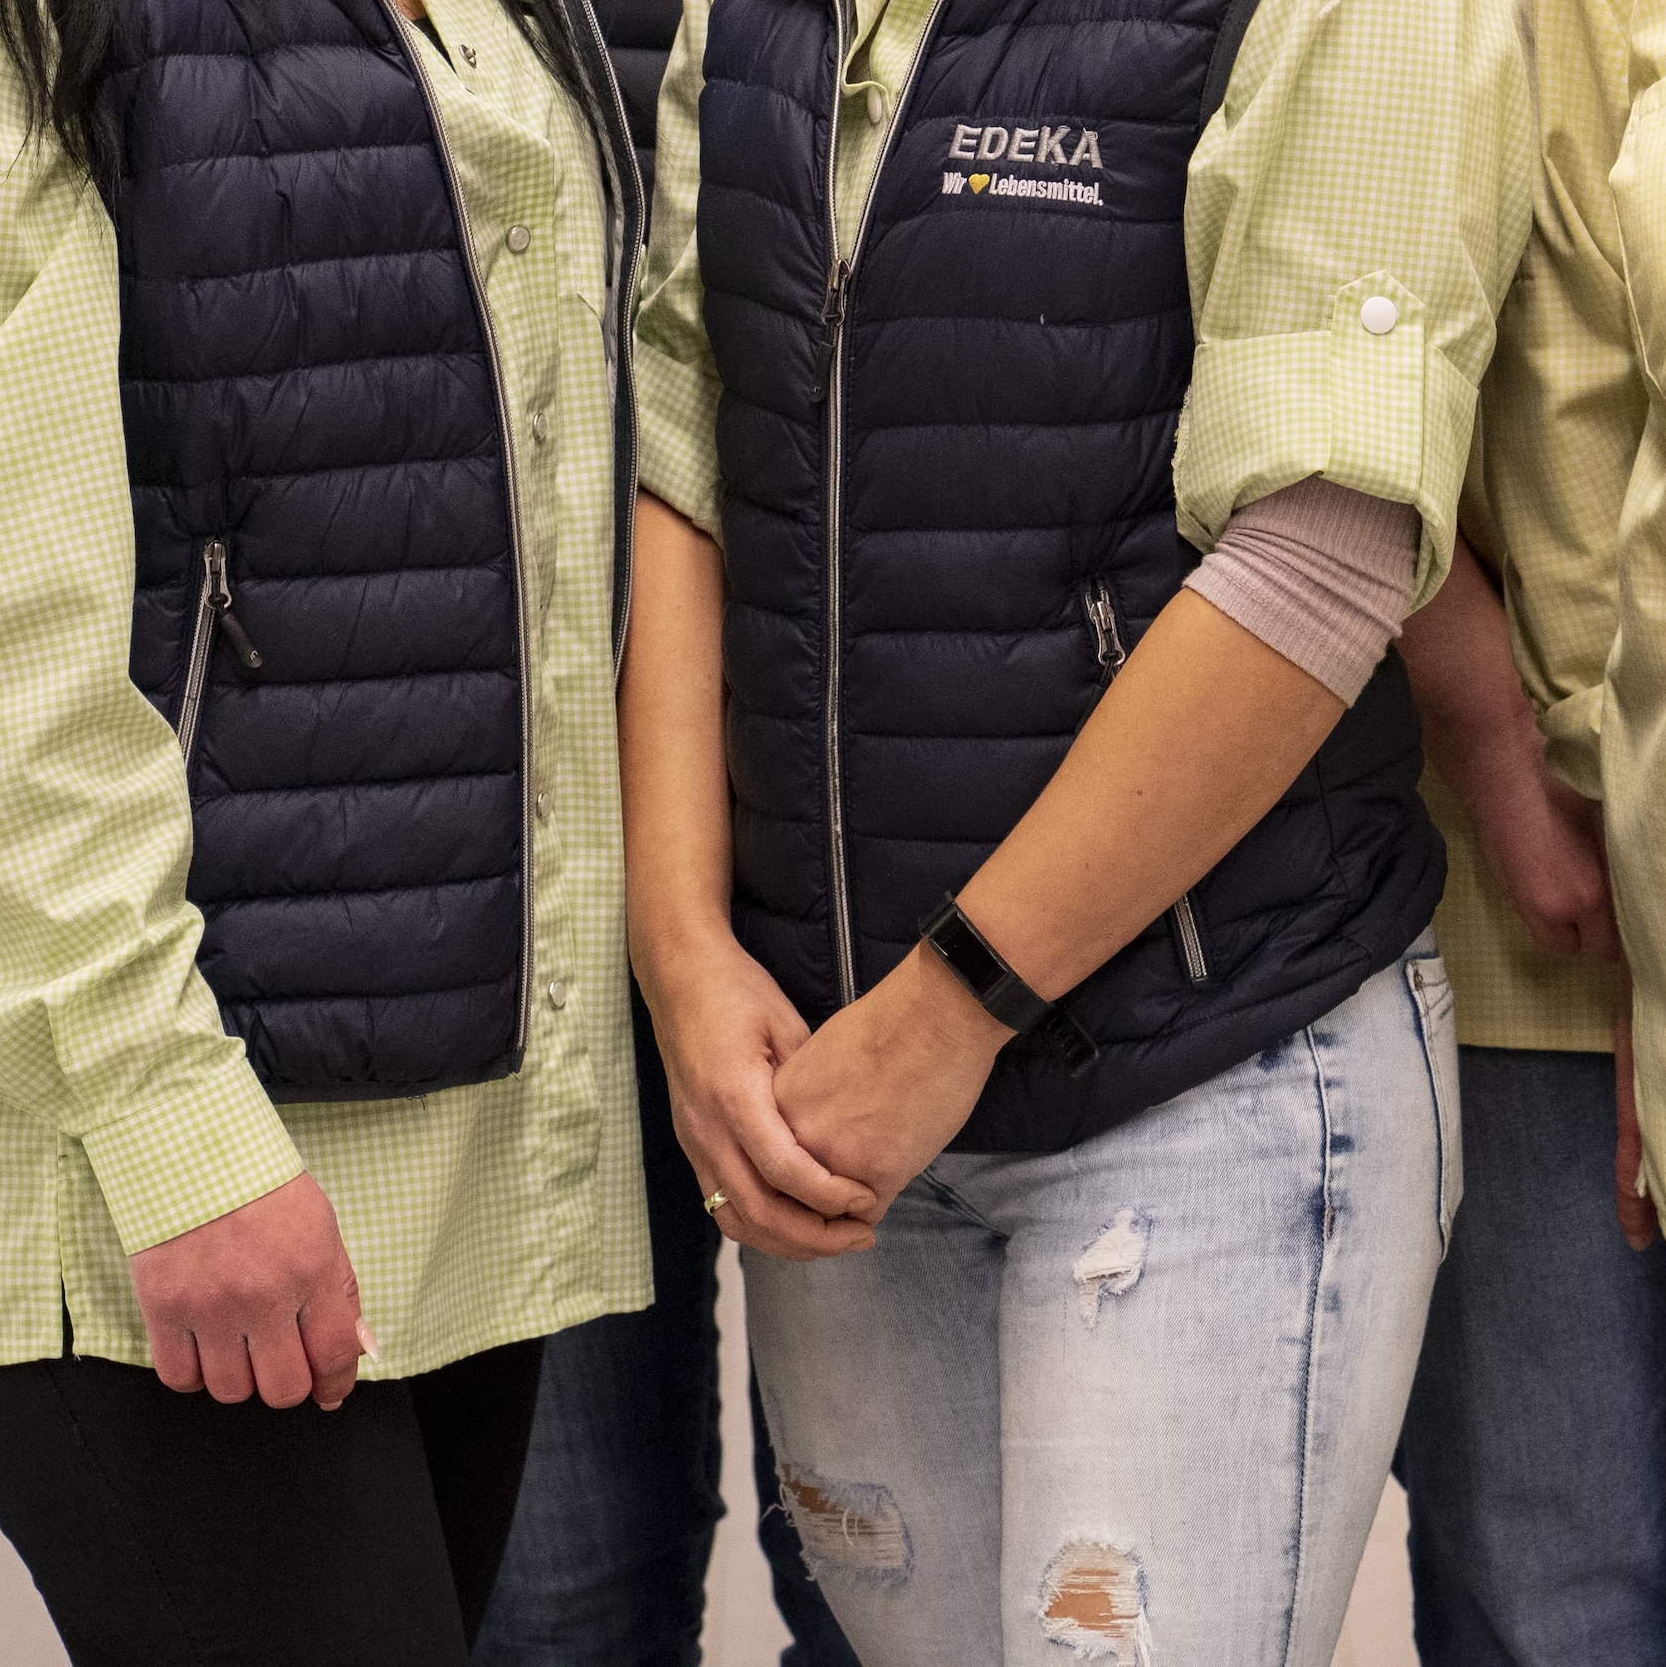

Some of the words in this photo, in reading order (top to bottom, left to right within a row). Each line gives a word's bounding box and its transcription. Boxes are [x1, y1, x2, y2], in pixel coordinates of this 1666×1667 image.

[948, 123, 1104, 169] EDEKA
[941, 171, 967, 195] Wir
[989, 173, 1104, 206] Lebensmittel.
